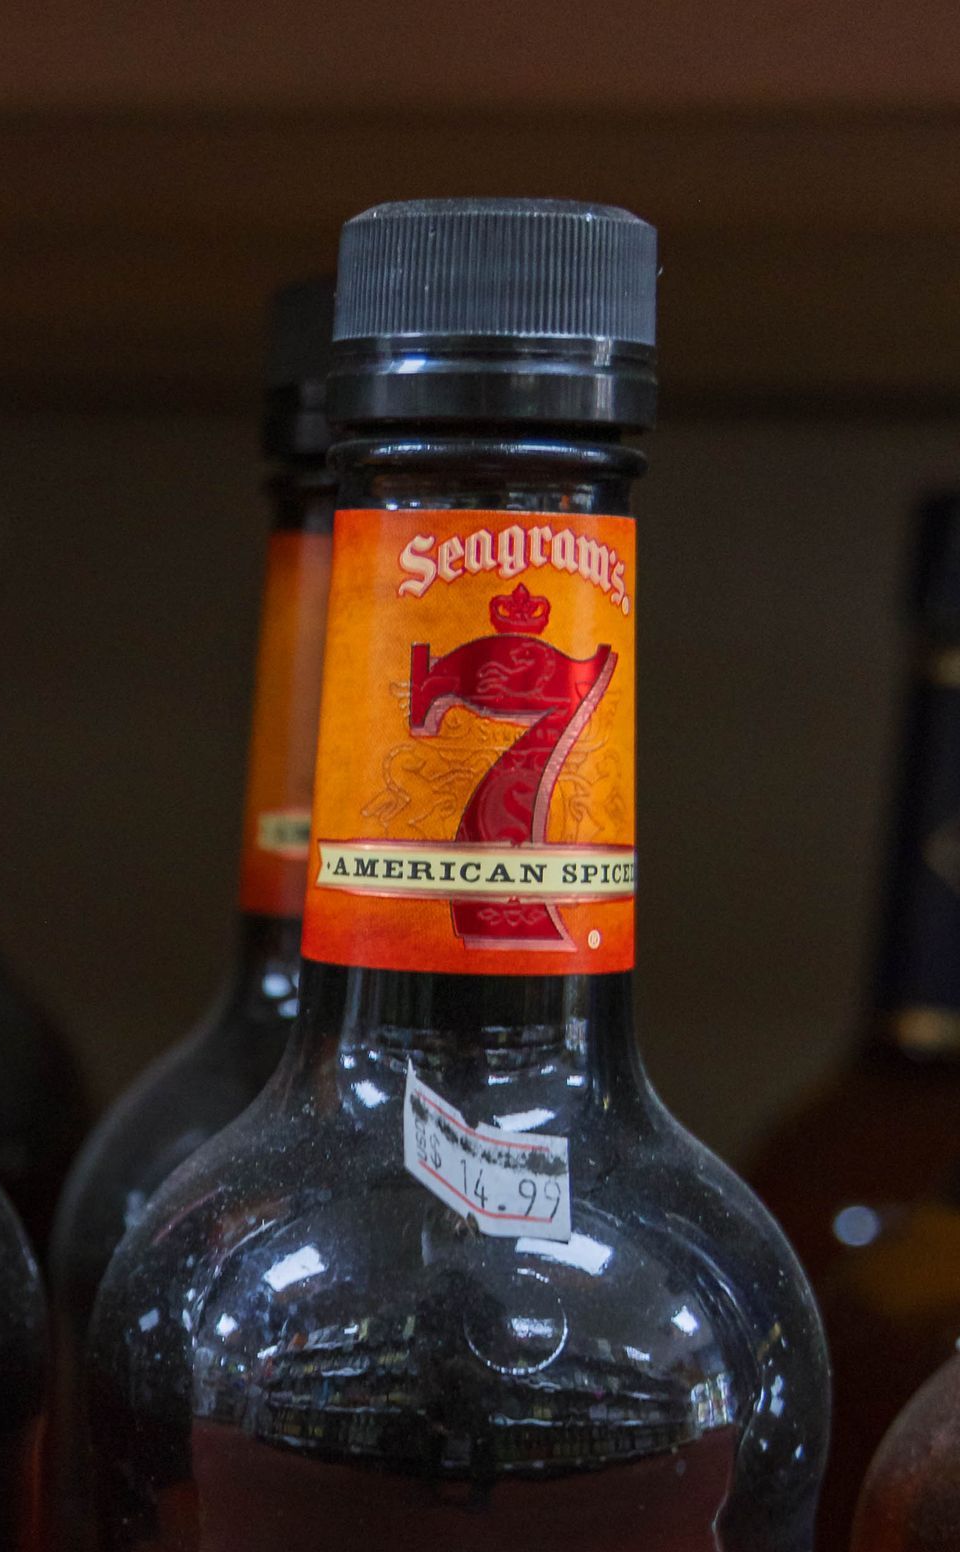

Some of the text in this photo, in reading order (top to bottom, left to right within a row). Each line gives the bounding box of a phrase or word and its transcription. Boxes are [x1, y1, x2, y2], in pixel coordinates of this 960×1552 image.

[409, 632, 618, 952] 7
[332, 858, 548, 884] AMERICAN
[460, 1158, 562, 1220] 14.99
